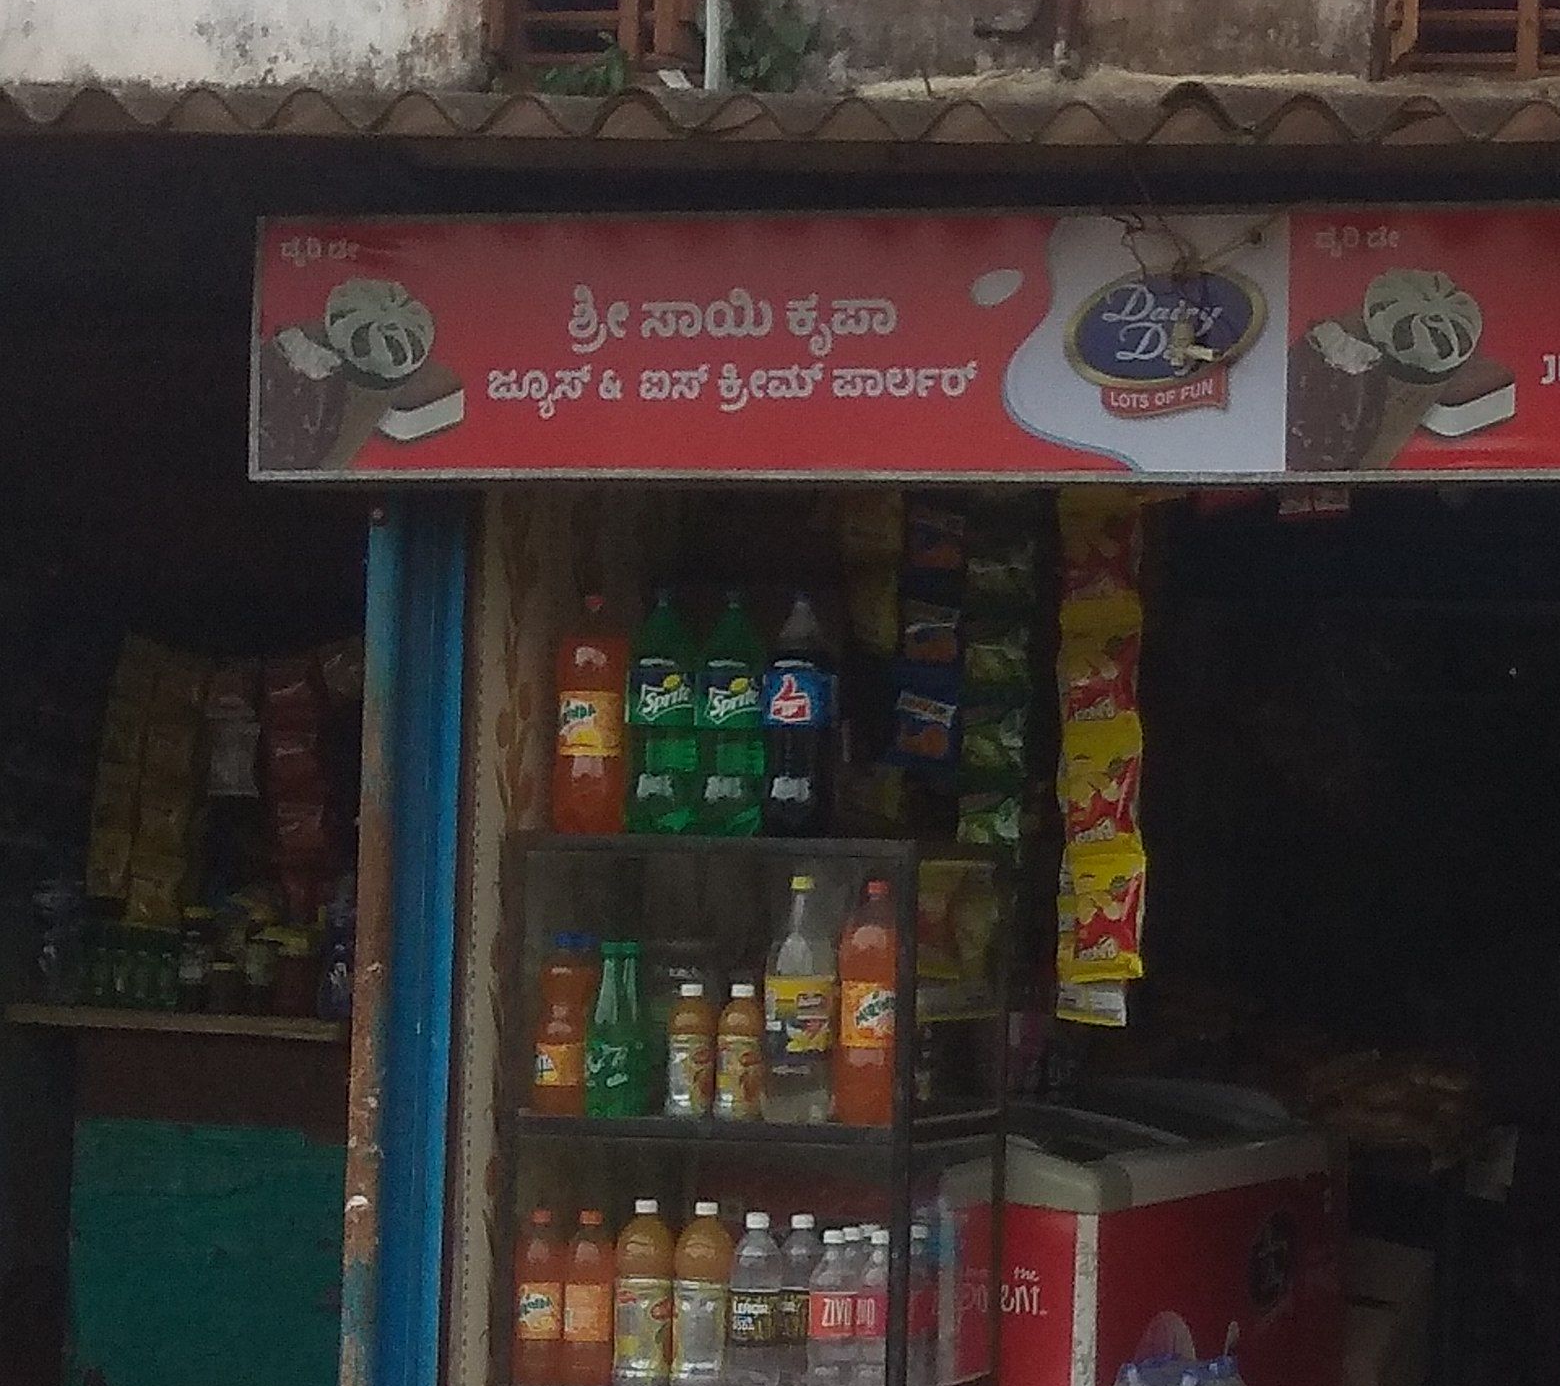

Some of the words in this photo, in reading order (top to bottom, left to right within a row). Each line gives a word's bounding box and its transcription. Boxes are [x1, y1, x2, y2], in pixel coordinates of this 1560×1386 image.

[568, 283, 629, 354] ಶ್ರೀ
[640, 288, 773, 338] ಸಾಯಿ
[786, 293, 898, 357] ಕೃಪಾ
[487, 363, 591, 420] ಜ್ಯೂಸ್
[599, 368, 623, 400] &
[639, 363, 709, 400] ಐಸ್
[718, 362, 822, 412] ಕ್ರೀಮ್
[1109, 390, 1150, 409] LOTS
[1154, 389, 1176, 405] OF
[1180, 378, 1214, 400] FUN
[645, 683, 691, 712] Sprite
